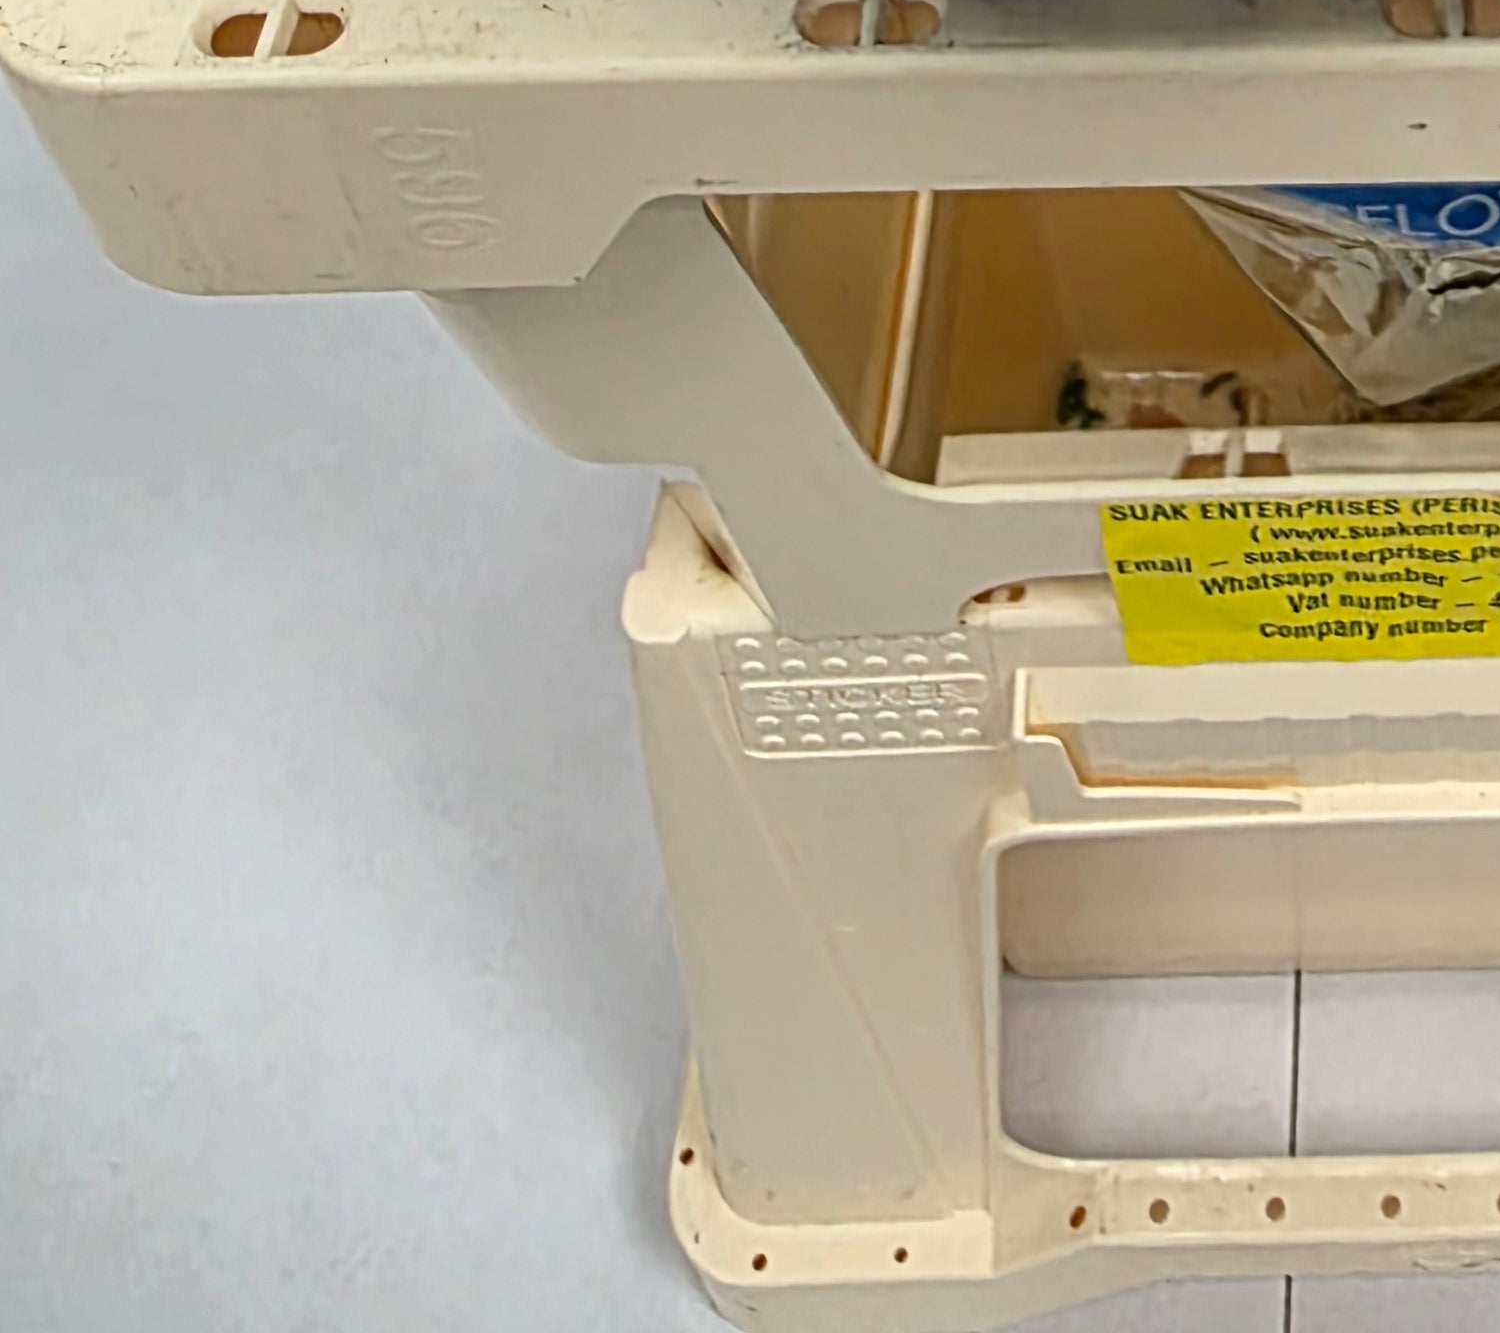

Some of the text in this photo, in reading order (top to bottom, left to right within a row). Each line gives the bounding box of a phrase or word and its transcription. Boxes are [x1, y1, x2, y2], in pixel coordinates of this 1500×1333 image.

[1109, 502, 1190, 522] SUAK
[1200, 498, 1401, 520] ENTERPRISES
[1115, 557, 1192, 575] Email
[1201, 569, 1334, 596] Whatsapp
[1345, 568, 1449, 588] number
[1287, 593, 1330, 614] Vat
[1339, 592, 1442, 611] number
[1259, 618, 1380, 642] Company
[1388, 618, 1491, 636] number
